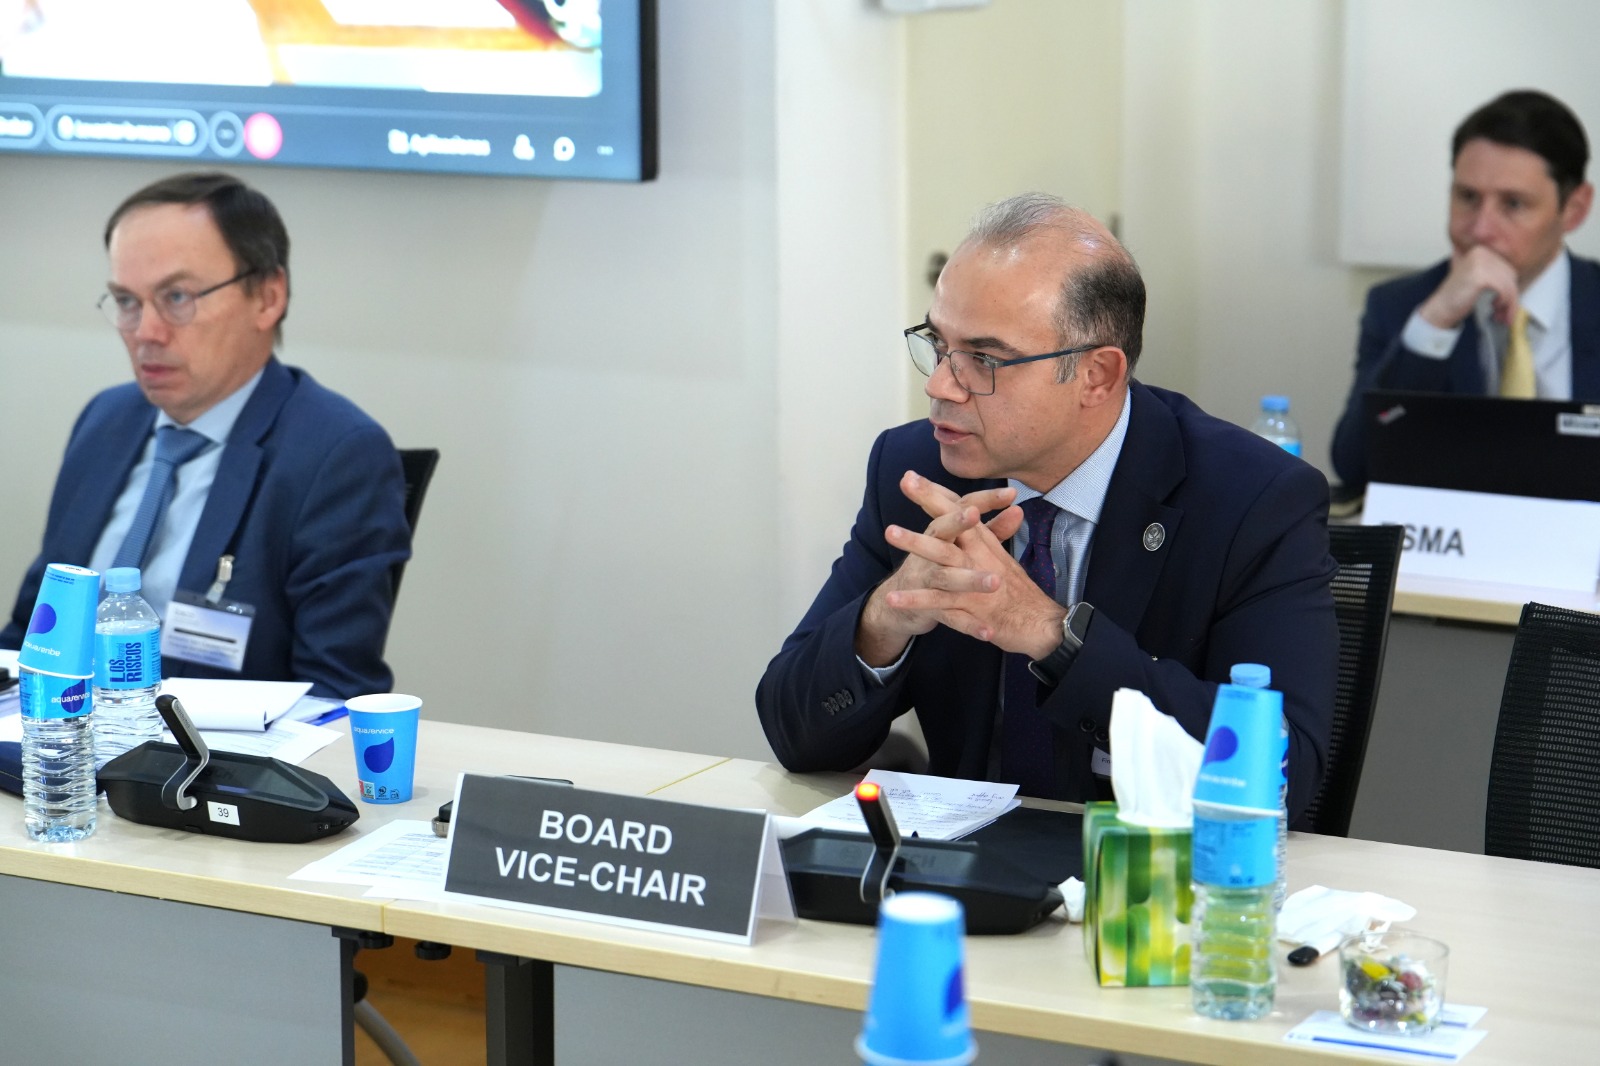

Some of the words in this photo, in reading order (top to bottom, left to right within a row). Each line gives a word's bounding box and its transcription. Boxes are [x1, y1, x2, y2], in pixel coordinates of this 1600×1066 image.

[1380, 521, 1465, 556] SMA
[109, 659, 125, 682] LOS
[125, 642, 142, 682] RISCOS
[217, 807, 229, 818] 39
[539, 809, 673, 855] BOARD
[495, 847, 707, 906] VICE-CHAIR
